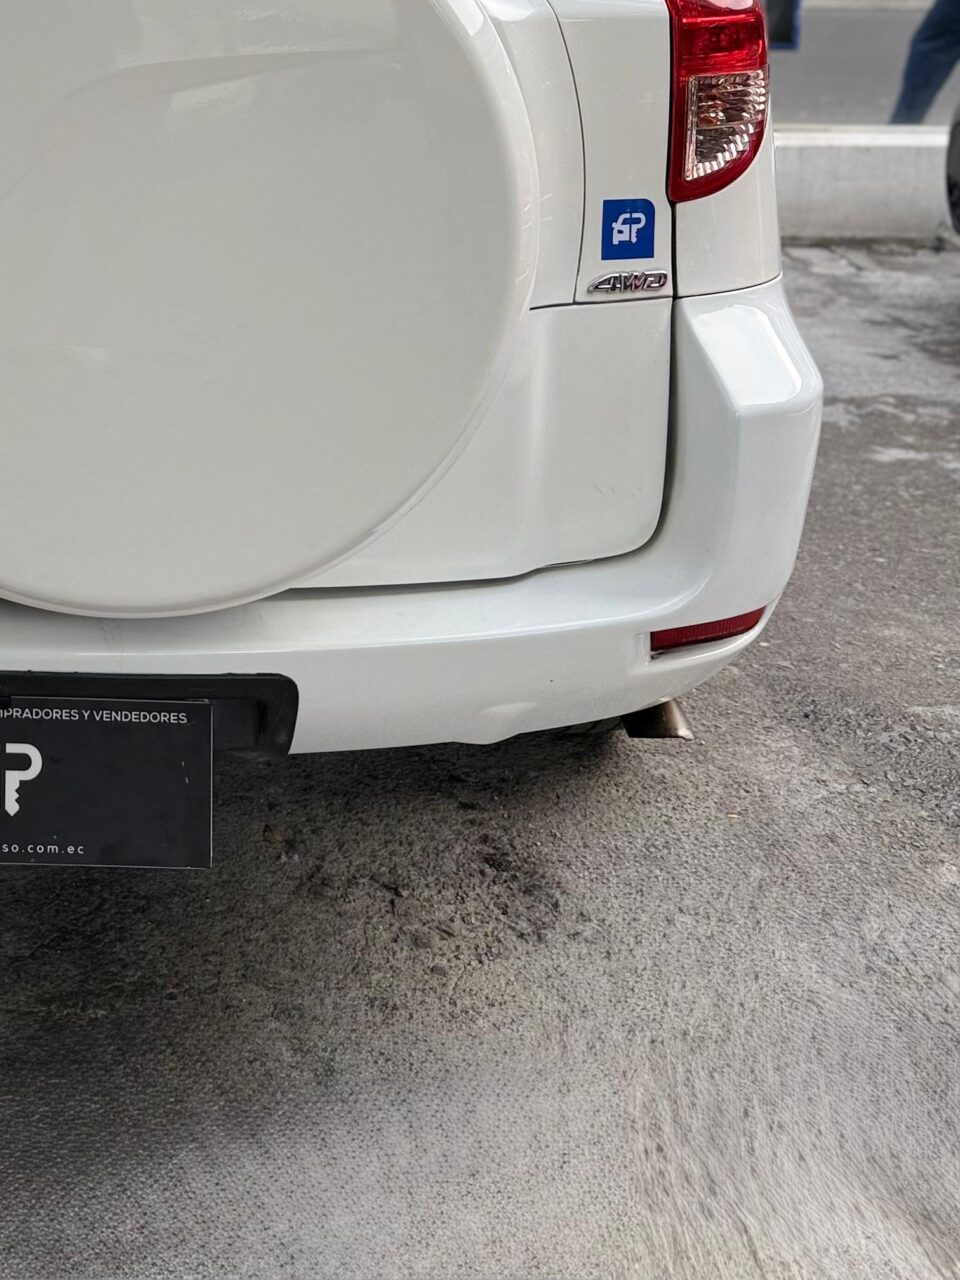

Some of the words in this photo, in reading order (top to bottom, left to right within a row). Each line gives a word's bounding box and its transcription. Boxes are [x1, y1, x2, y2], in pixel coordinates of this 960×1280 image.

[587, 270, 668, 294] 4WD
[81, 709, 91, 720] Y
[93, 710, 188, 724] VENDEDORES
